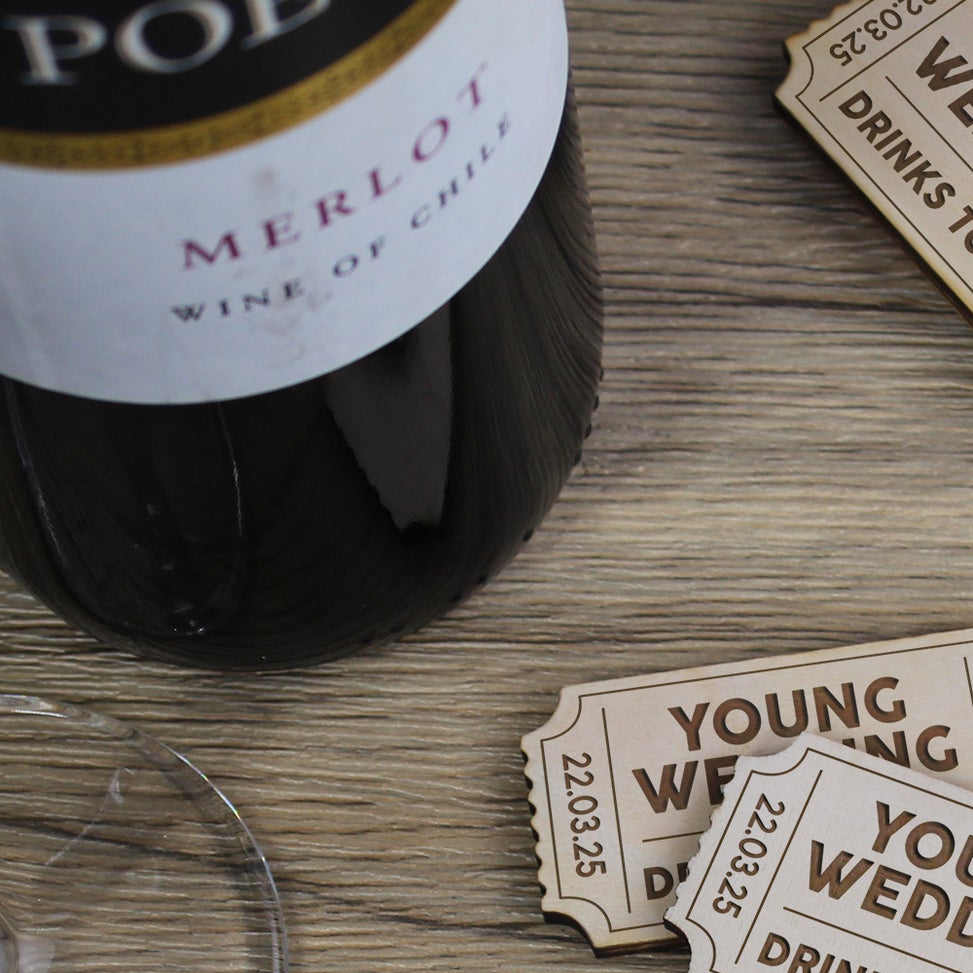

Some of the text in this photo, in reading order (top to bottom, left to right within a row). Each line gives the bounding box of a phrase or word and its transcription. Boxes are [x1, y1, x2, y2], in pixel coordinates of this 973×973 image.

[829, 0, 937, 66] 2.03.25
[180, 60, 488, 272] MERLOT
[838, 91, 956, 210] DRINKS
[170, 114, 510, 323] WINE OF CHILE
[668, 676, 908, 751] YOUNG
[562, 752, 606, 878] 22.03.25
[712, 793, 785, 918] 22.03.25
